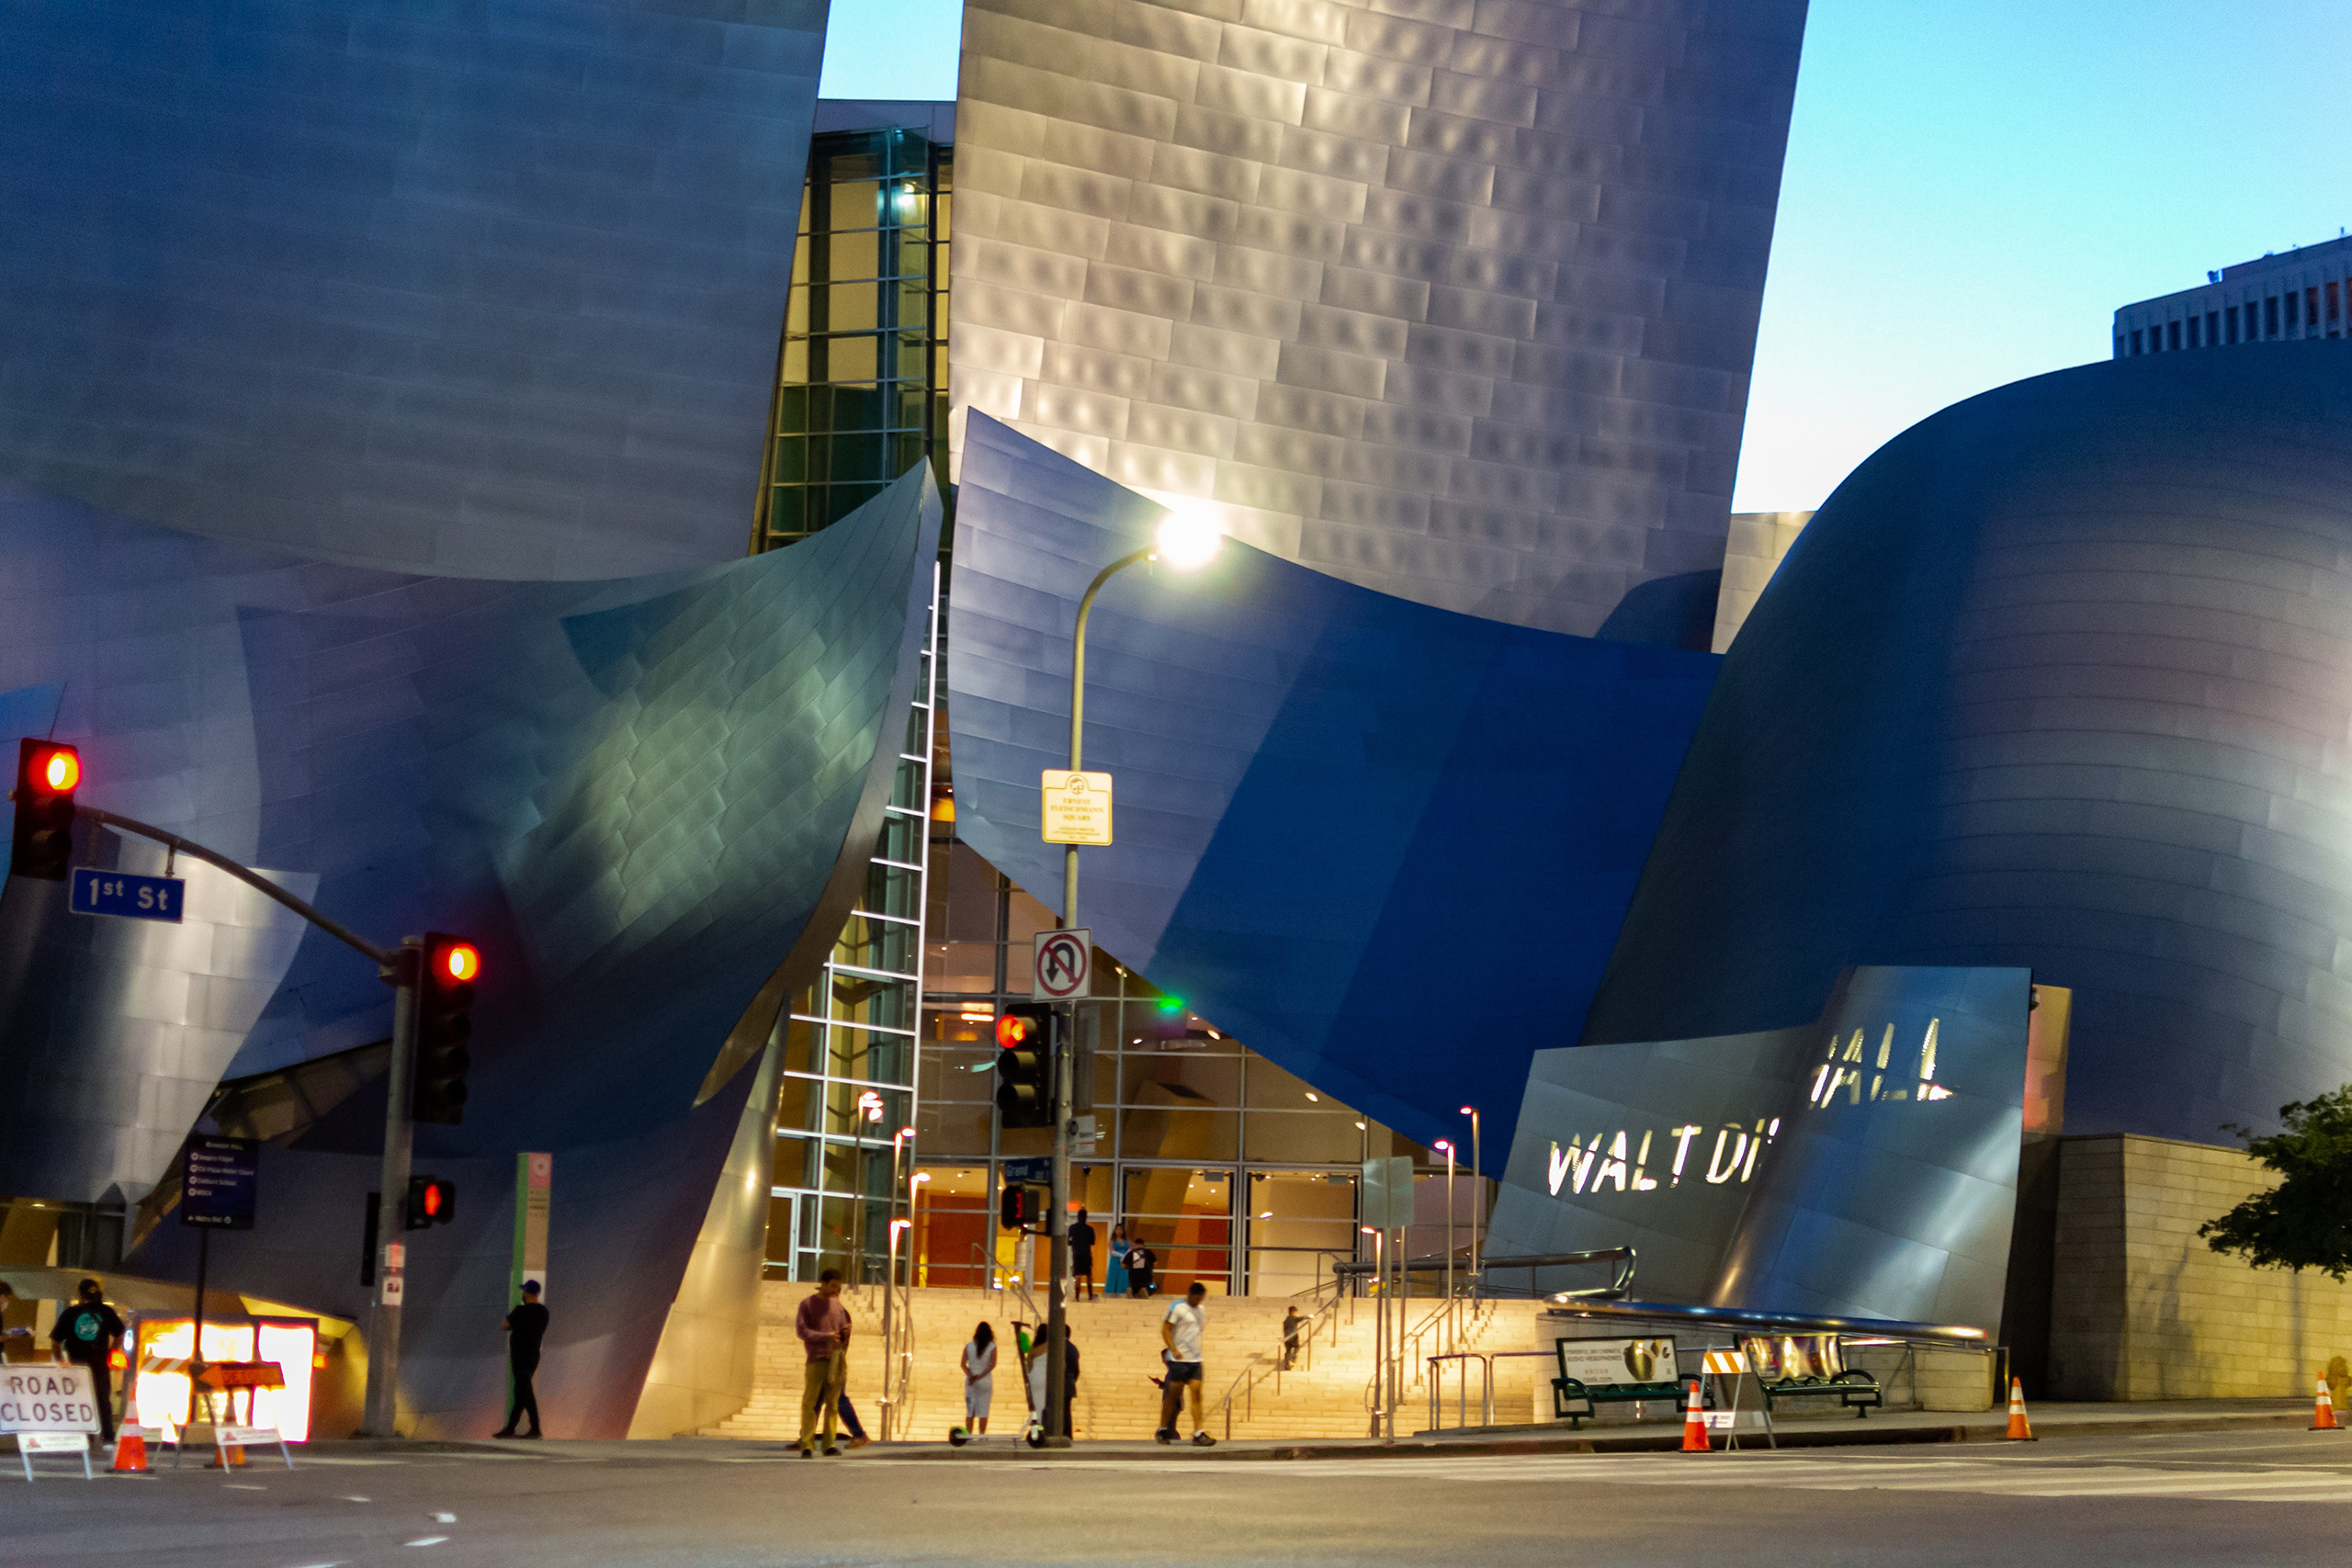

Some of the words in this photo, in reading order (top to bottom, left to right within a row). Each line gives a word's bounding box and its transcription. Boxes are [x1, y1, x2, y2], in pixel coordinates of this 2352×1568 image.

[90, 878, 124, 906] 1st
[137, 886, 168, 911] St
[1548, 1124, 1702, 1196] WALT
[1006, 1164, 1028, 1177] Grand
[9, 1376, 75, 1395] ROAD
[0, 1403, 93, 1422] CLOSED
